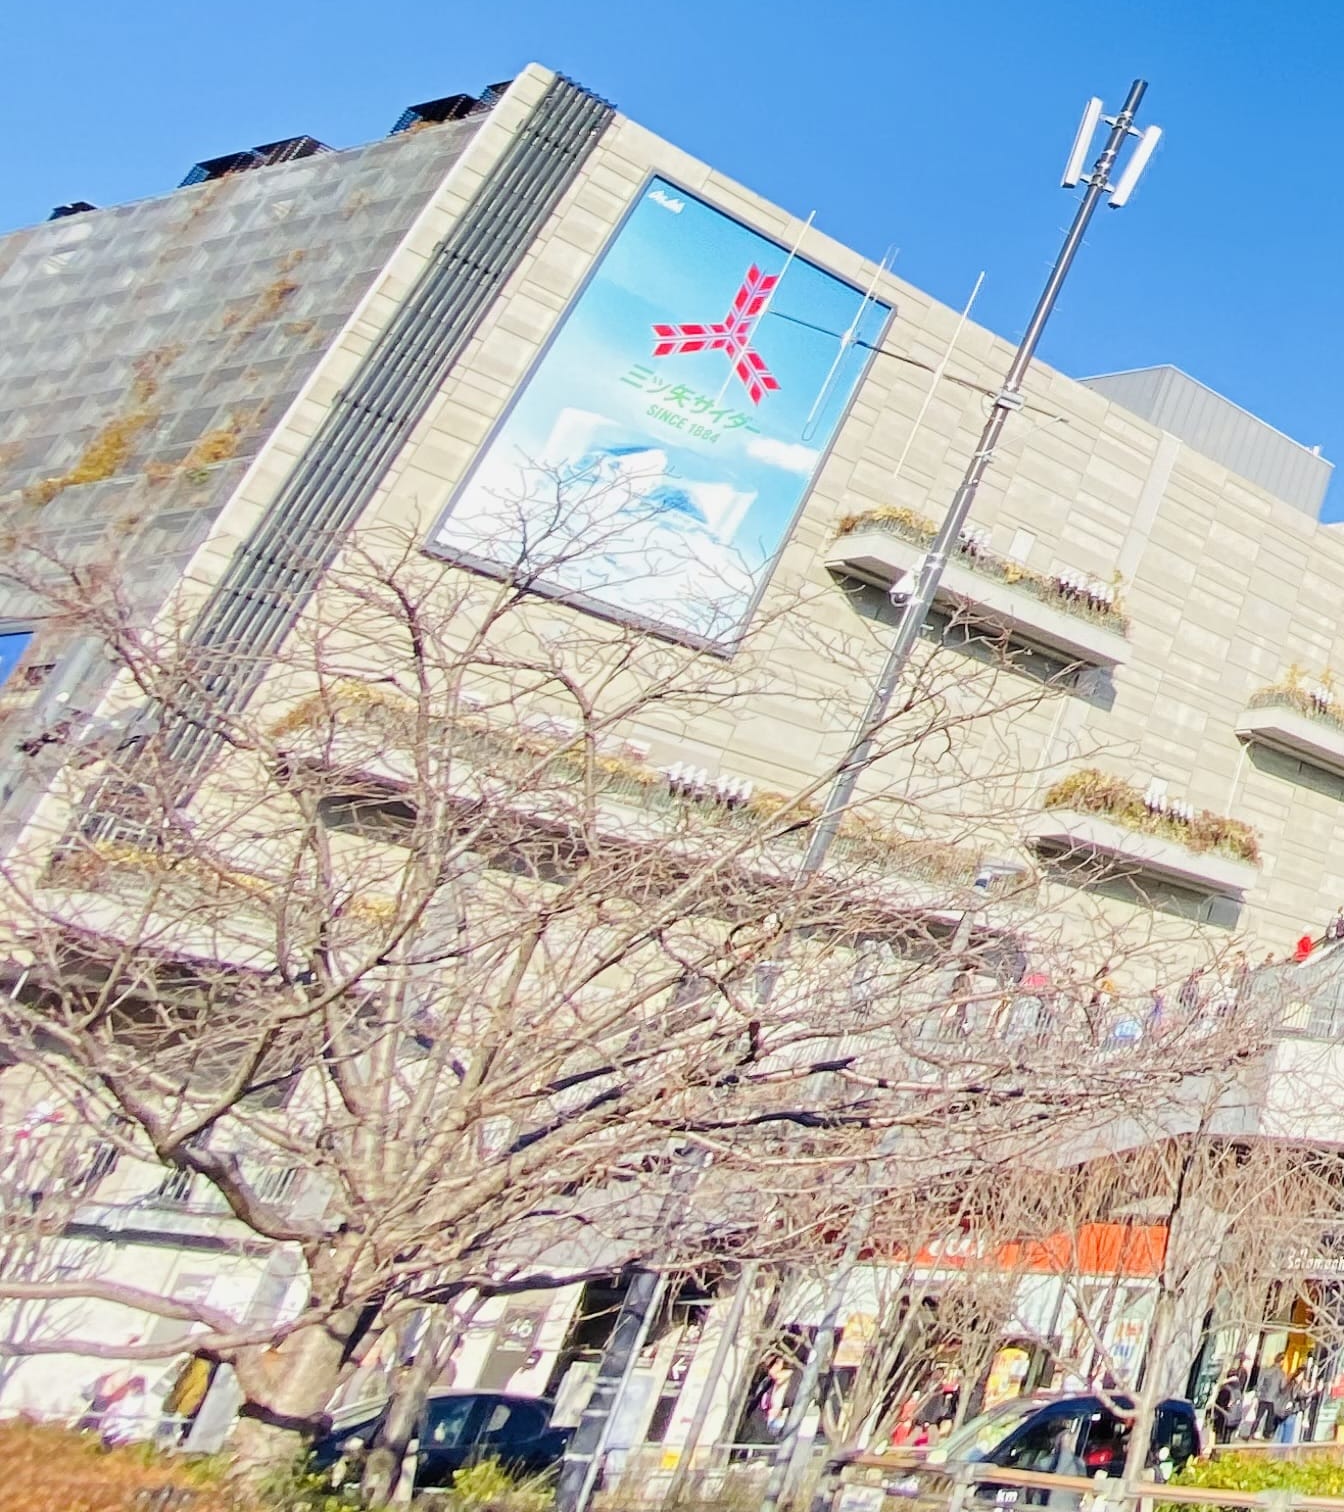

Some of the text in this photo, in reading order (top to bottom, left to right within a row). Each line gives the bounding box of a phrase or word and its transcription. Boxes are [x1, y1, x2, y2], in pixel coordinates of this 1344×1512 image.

[619, 363, 761, 435] 三ツ矢サイダー
[645, 403, 721, 444] SINCE 1884
